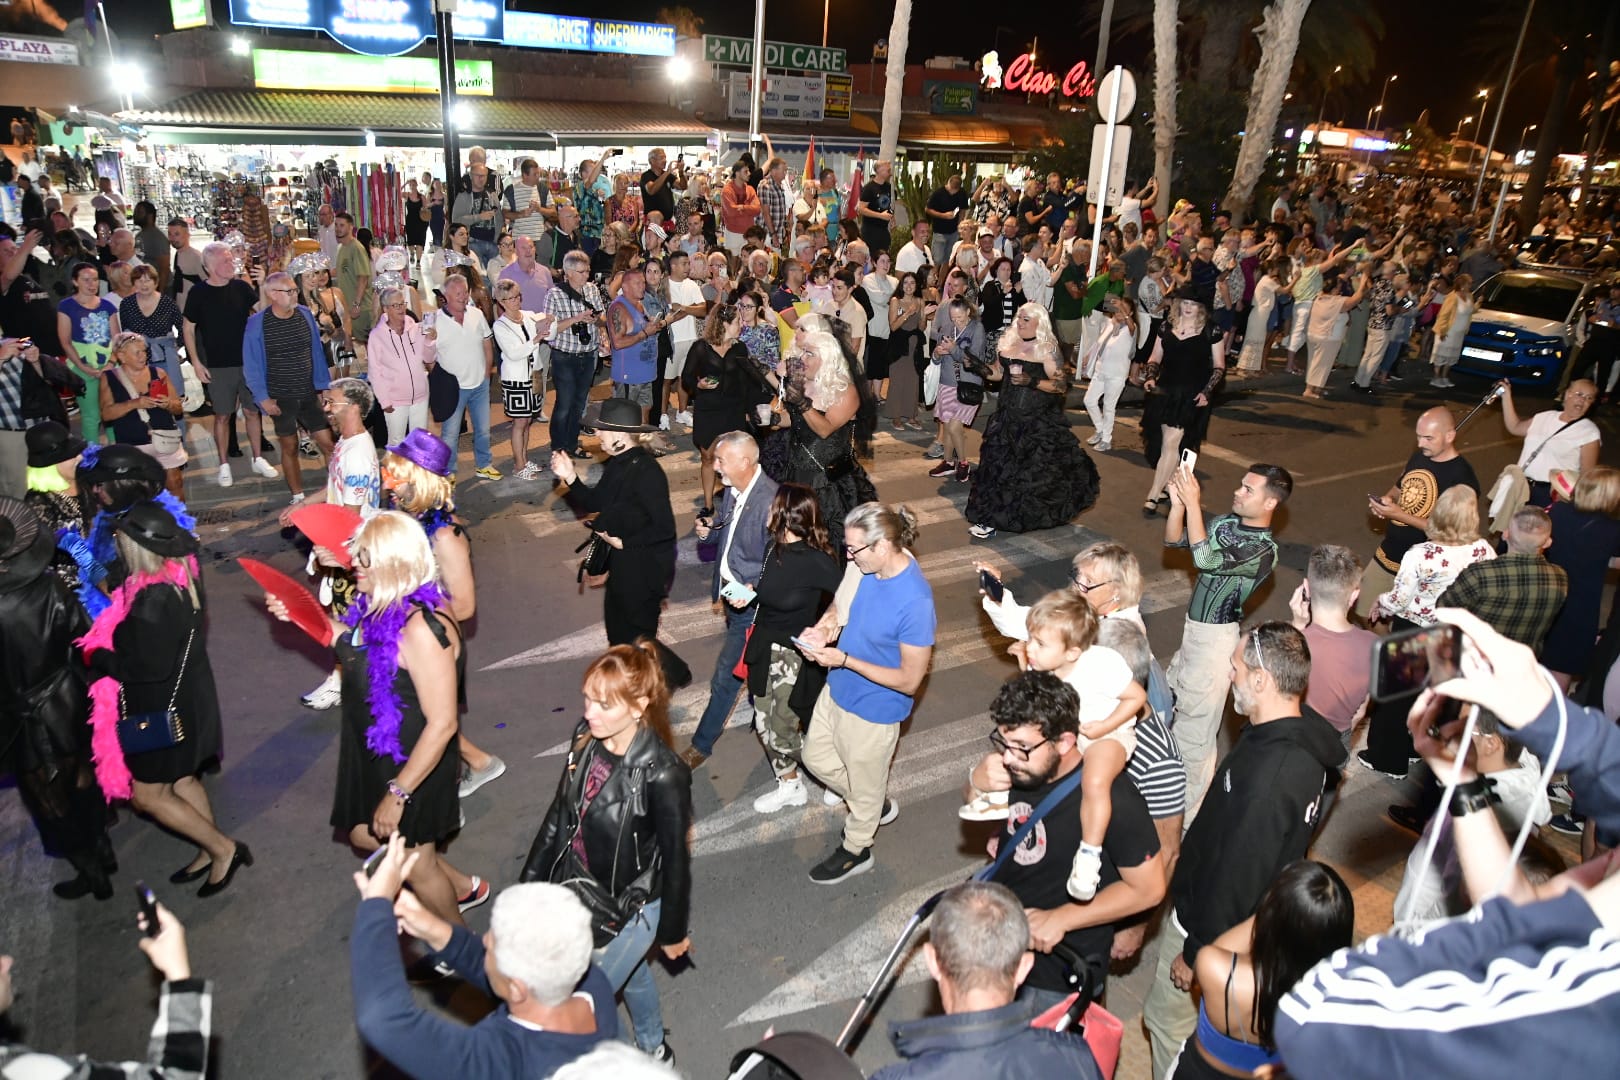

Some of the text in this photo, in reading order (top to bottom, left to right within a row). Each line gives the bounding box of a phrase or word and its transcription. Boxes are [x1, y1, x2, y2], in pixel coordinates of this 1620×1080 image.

[0, 39, 52, 55] PLAYA
[593, 21, 674, 48] SUPERMARKET
[729, 41, 843, 71] MDI CARE
[1004, 53, 1056, 94] Ciao
